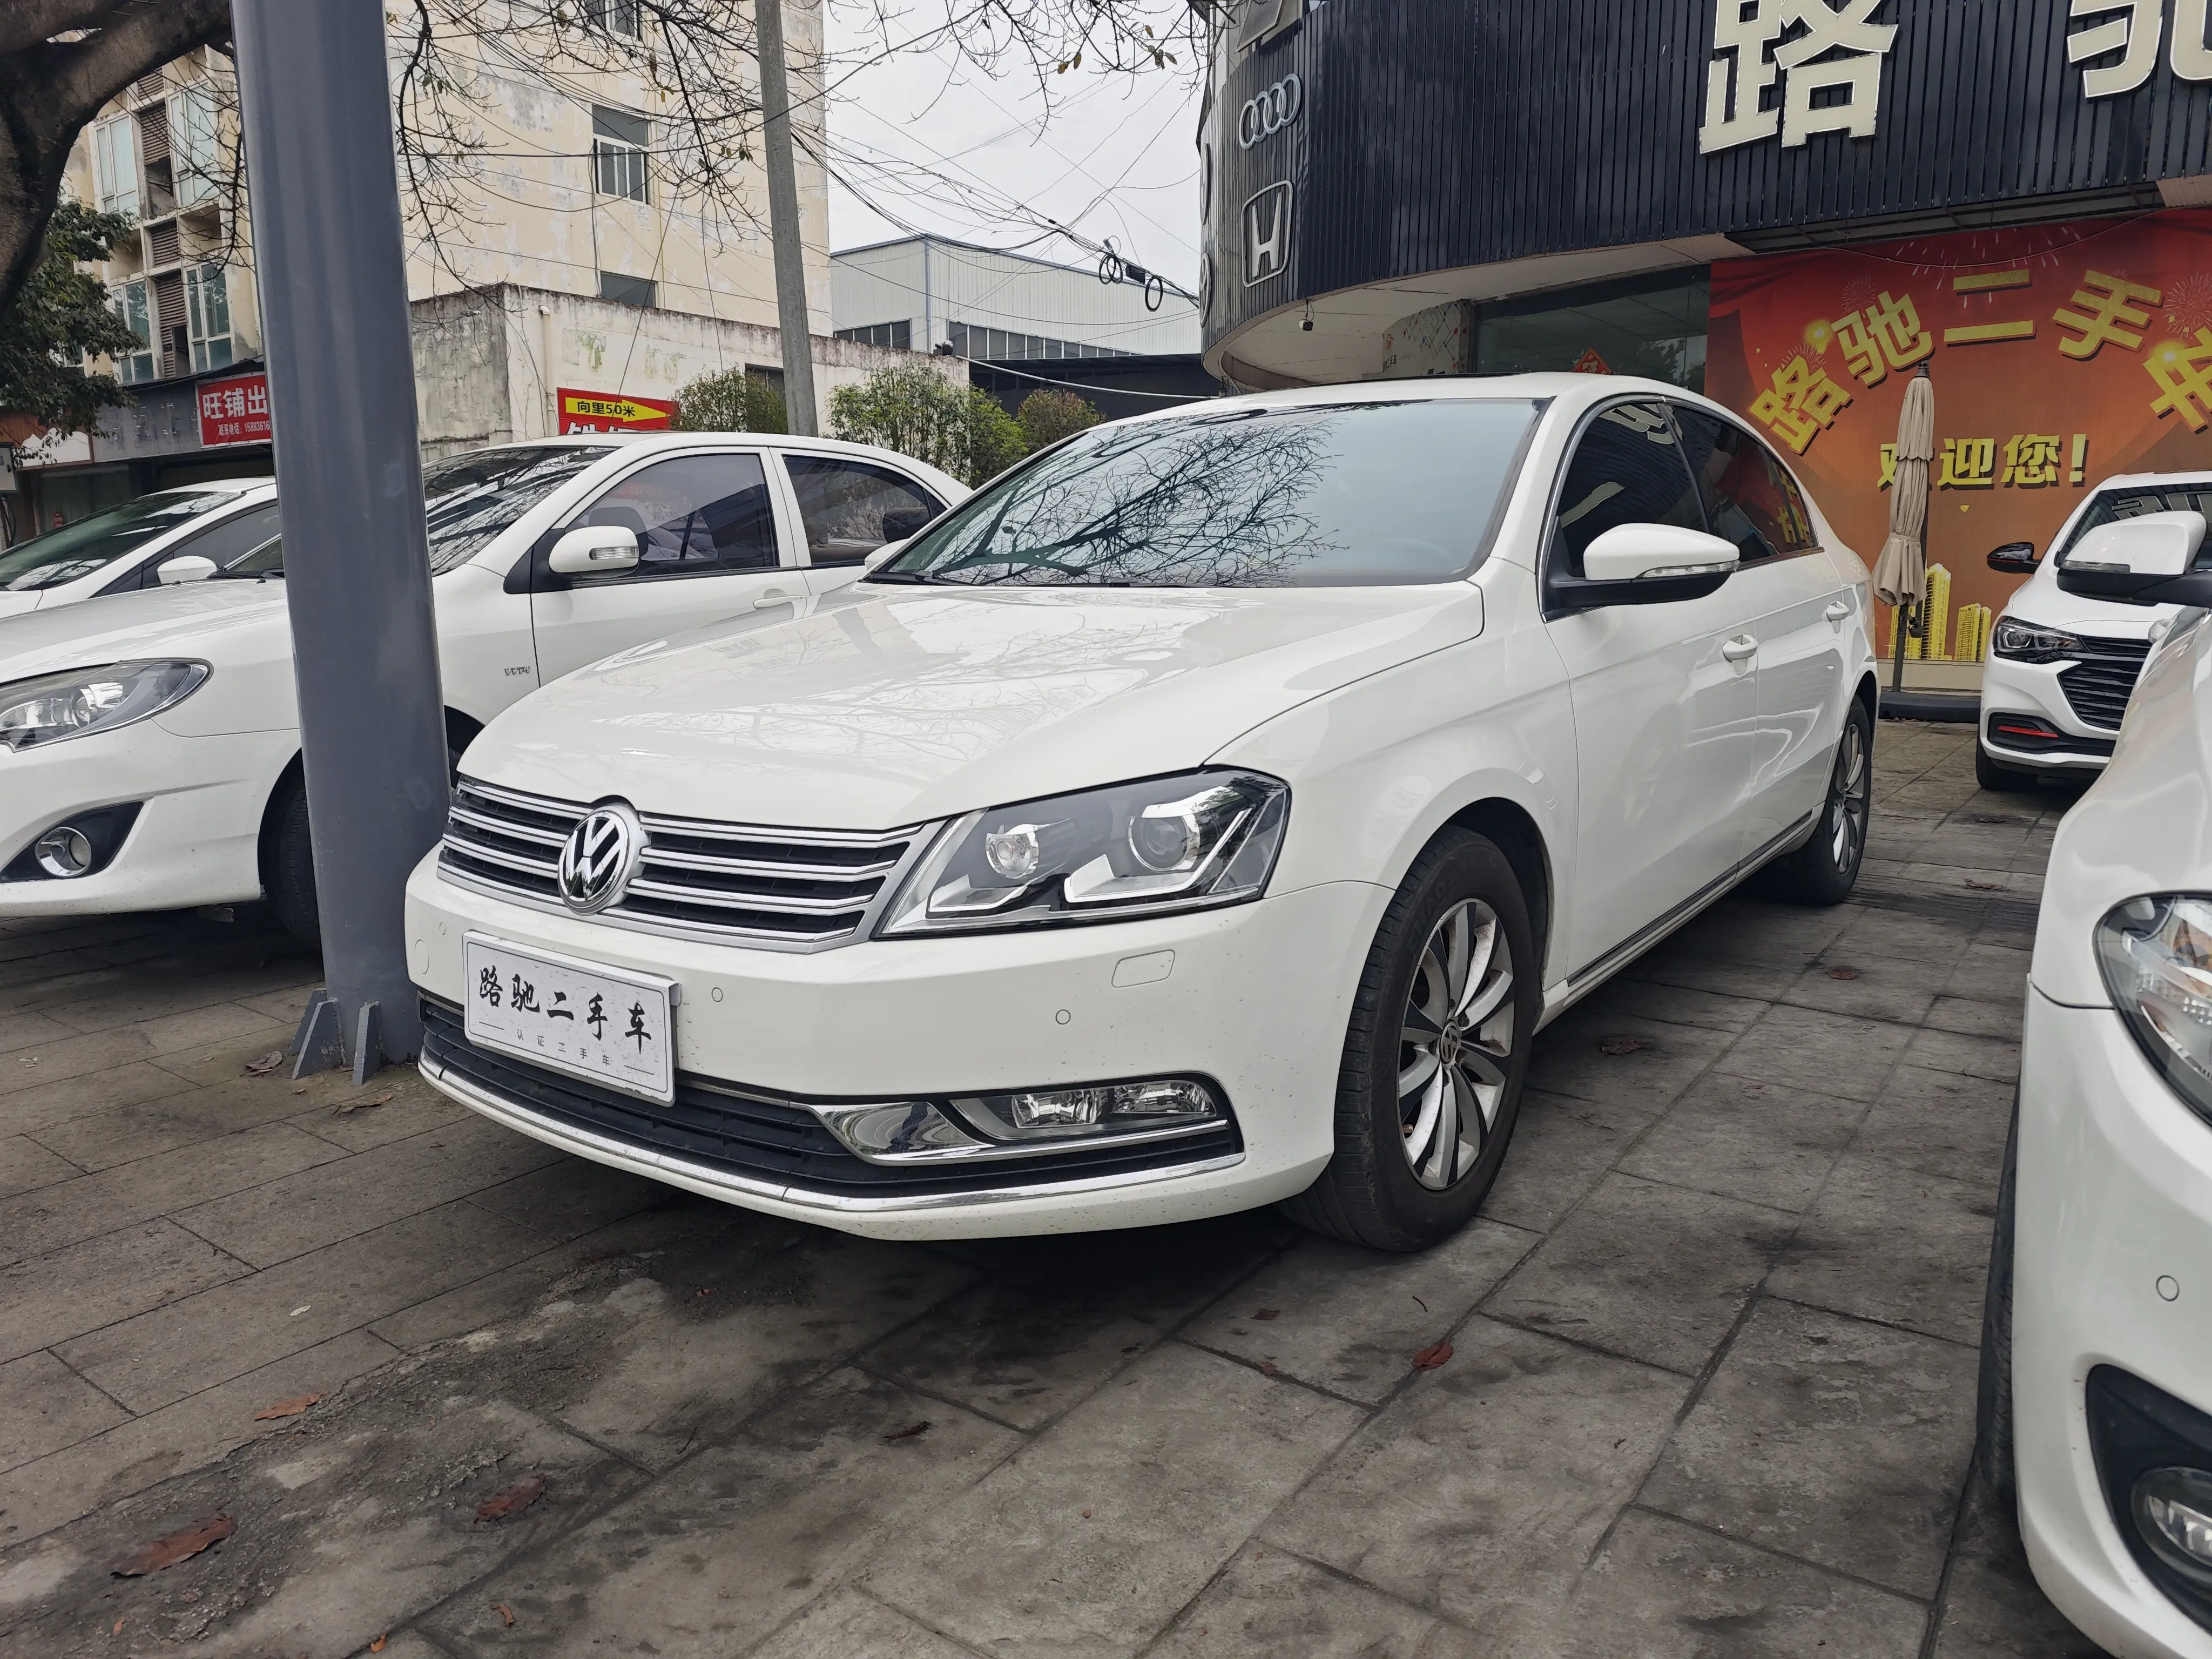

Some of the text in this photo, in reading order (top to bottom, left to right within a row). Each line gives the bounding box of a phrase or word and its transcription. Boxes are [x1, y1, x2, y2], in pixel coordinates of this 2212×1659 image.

[202, 385, 268, 419] 旺铺出
[577, 400, 635, 417] 向里50米
[480, 966, 652, 1055] 路驰二手车
[516, 1029, 610, 1066] 认证二手车
